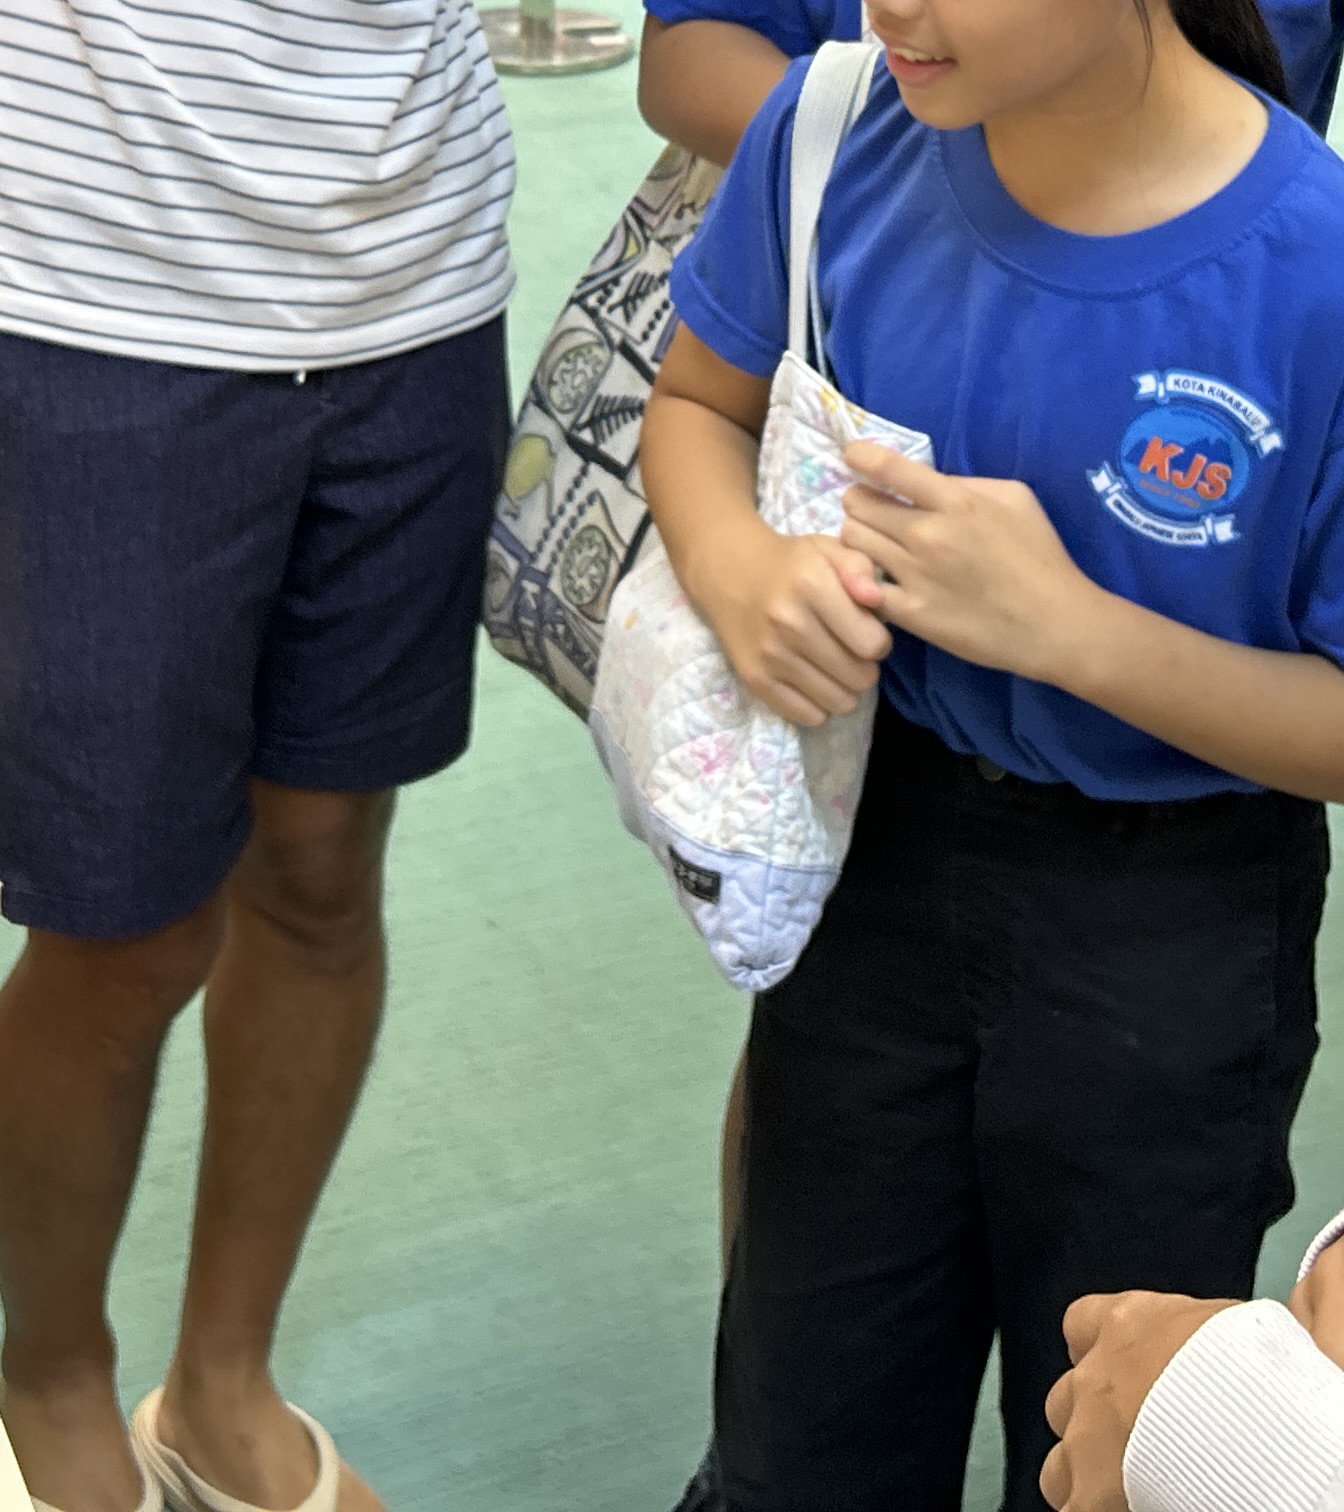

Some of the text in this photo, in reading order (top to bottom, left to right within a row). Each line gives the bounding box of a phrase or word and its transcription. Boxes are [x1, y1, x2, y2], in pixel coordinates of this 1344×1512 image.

[1173, 377, 1262, 427] KOTA KINABALU
[1138, 435, 1233, 500] KJS
